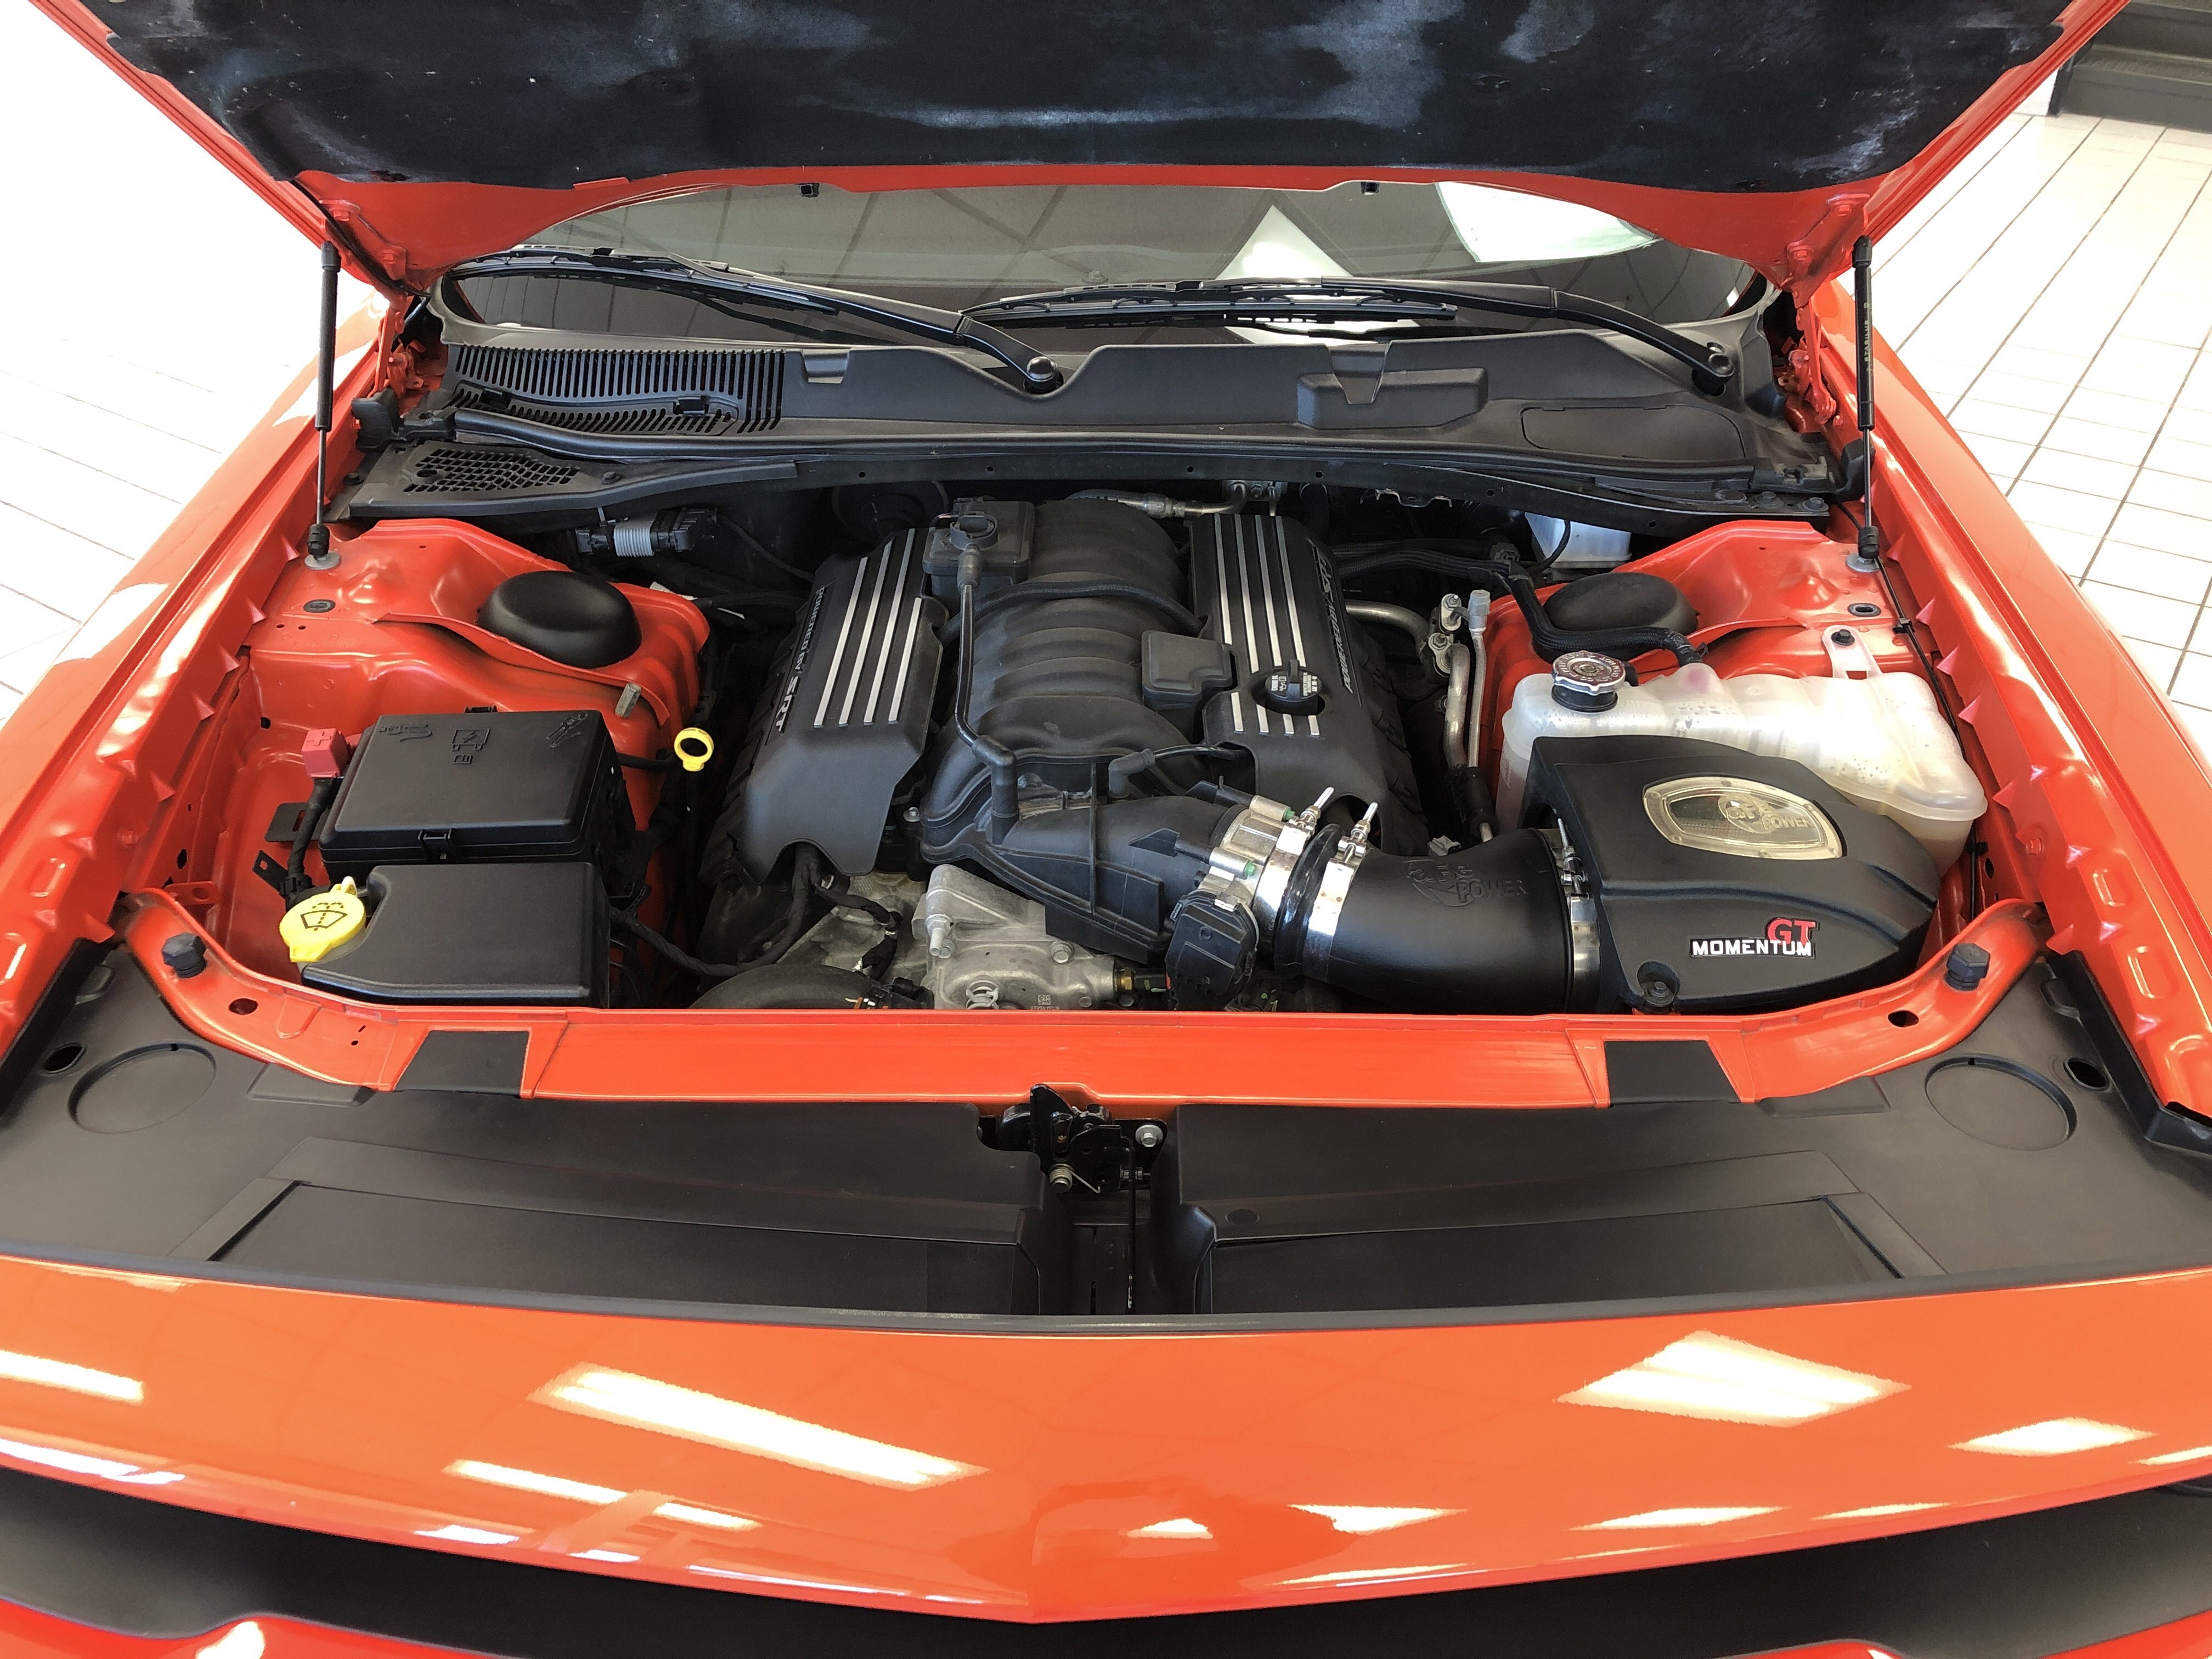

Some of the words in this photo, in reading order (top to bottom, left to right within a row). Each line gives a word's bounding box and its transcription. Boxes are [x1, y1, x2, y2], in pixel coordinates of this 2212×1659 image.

[1316, 547, 1334, 602] SRT
[801, 586, 825, 651] POWERED
[794, 652, 805, 670] BY
[1331, 621, 1353, 694] POWERED
[776, 676, 799, 732] SRT
[1762, 814, 1813, 830] POWER
[1456, 878, 1528, 904] POWER
[1767, 918, 1816, 946] GT
[1692, 939, 1811, 956] MOMENTUM
